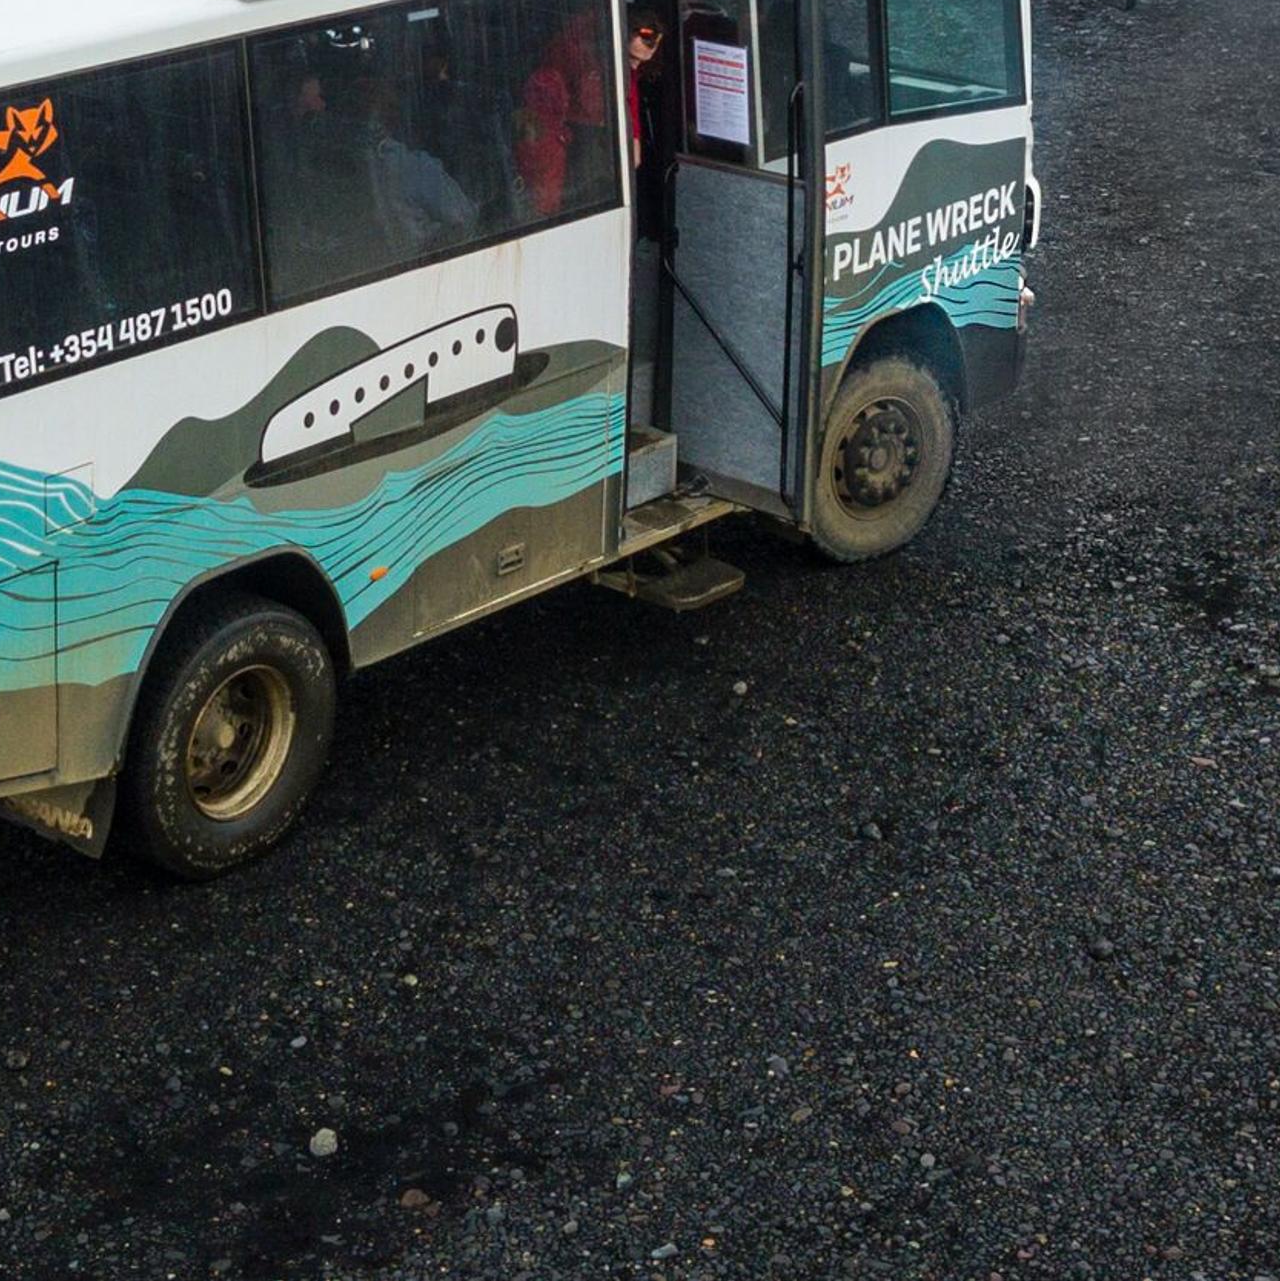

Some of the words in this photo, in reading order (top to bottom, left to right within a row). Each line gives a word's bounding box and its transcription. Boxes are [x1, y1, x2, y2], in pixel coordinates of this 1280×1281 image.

[833, 216, 922, 281] PLANE
[926, 180, 1017, 246] WRECK
[920, 226, 1020, 302] Shuttle
[49, 323, 115, 365] +354
[119, 307, 166, 347] 487
[171, 287, 233, 333] 1500
